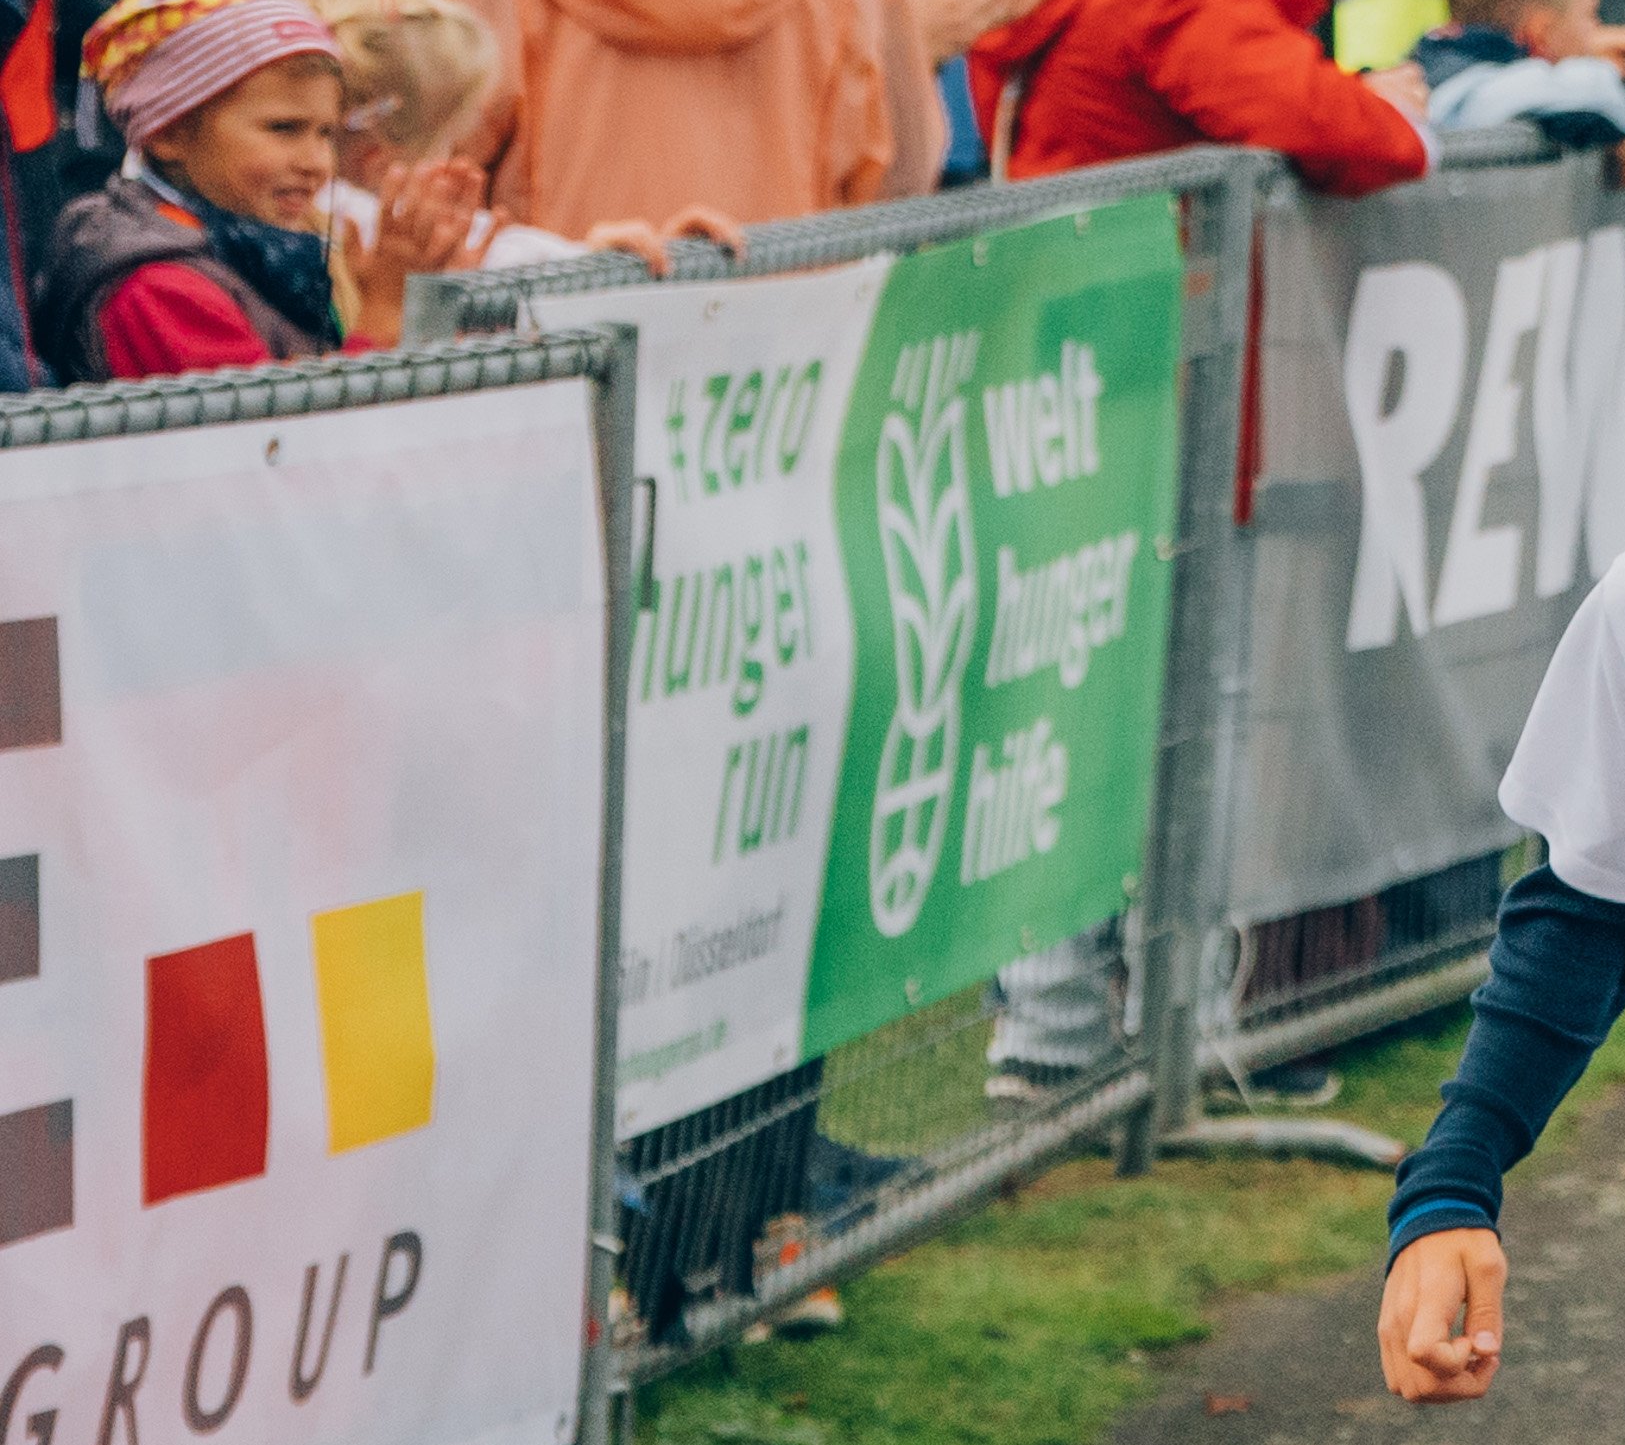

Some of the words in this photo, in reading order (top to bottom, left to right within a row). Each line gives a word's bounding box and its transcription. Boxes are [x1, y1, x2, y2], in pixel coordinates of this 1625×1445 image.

[983, 338, 1104, 497] welt
[986, 529, 1140, 688] hunger
[712, 723, 809, 864] run
[961, 718, 1068, 886] hilfe
